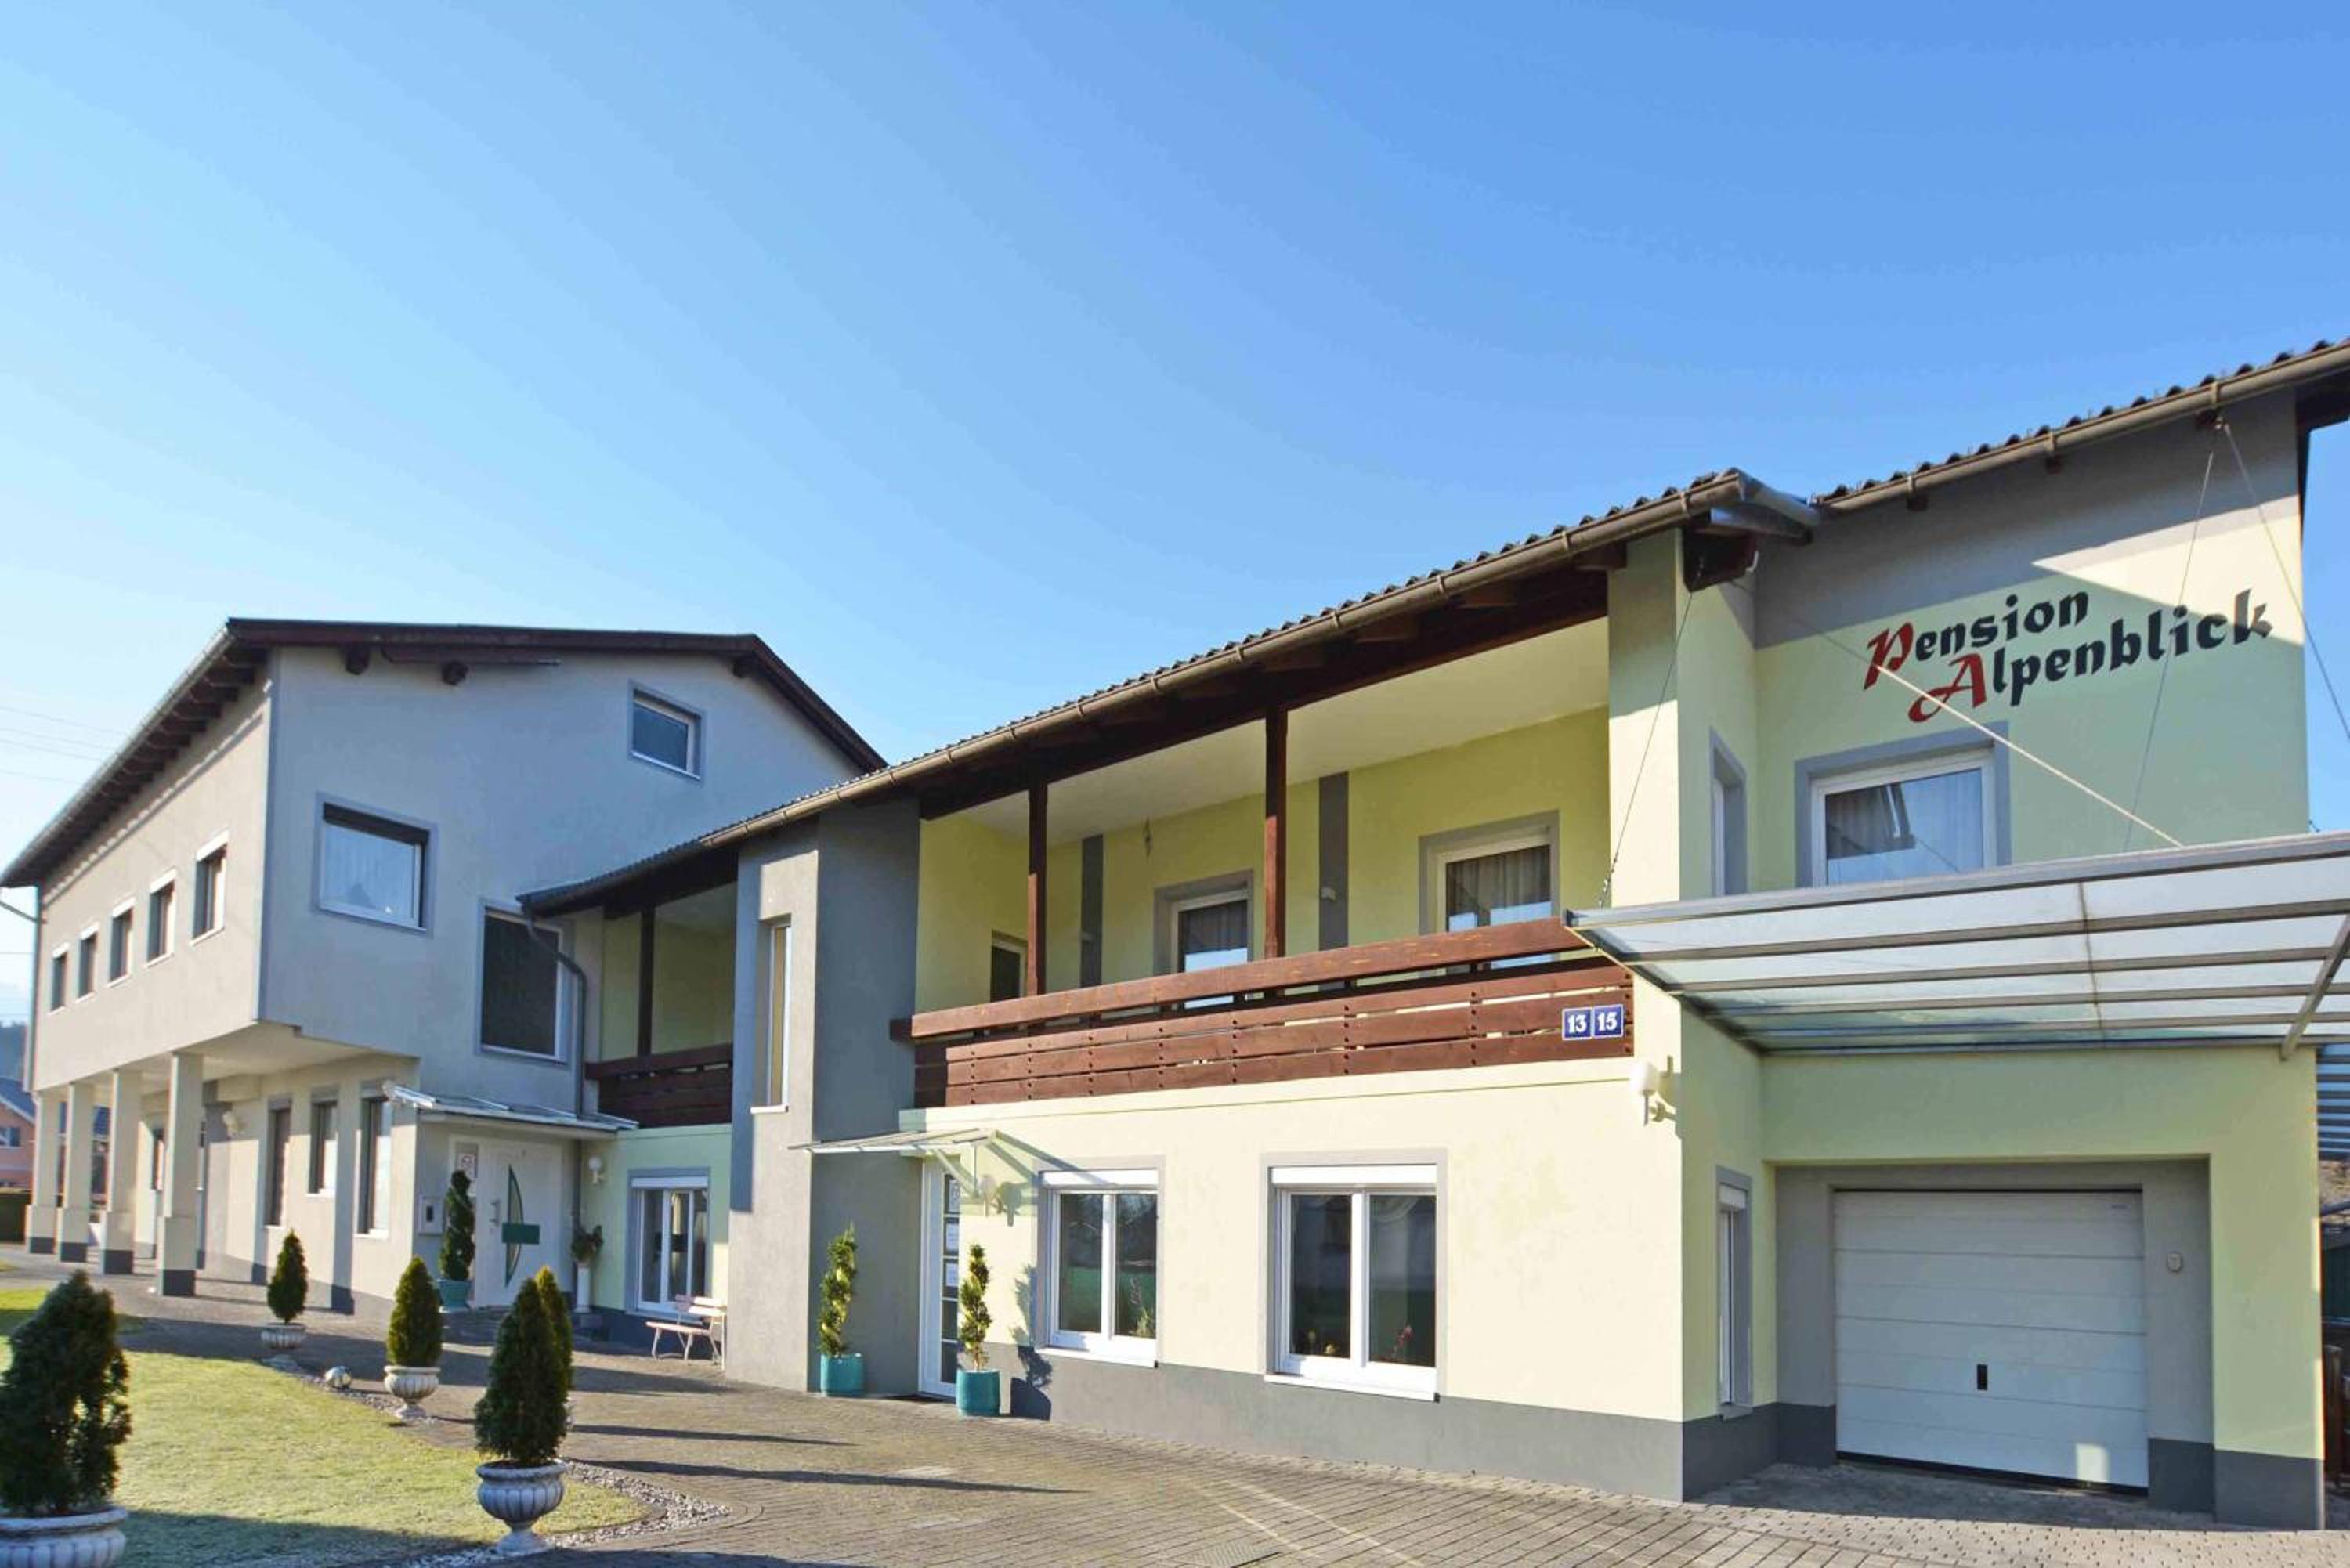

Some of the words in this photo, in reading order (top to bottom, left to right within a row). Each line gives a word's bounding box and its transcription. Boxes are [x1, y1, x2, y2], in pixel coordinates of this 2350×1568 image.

[1864, 590, 2089, 690] Pension
[1907, 588, 2273, 722] Alpenblick
[1567, 1014, 1587, 1033] 13
[1597, 1012, 1618, 1031] 15
